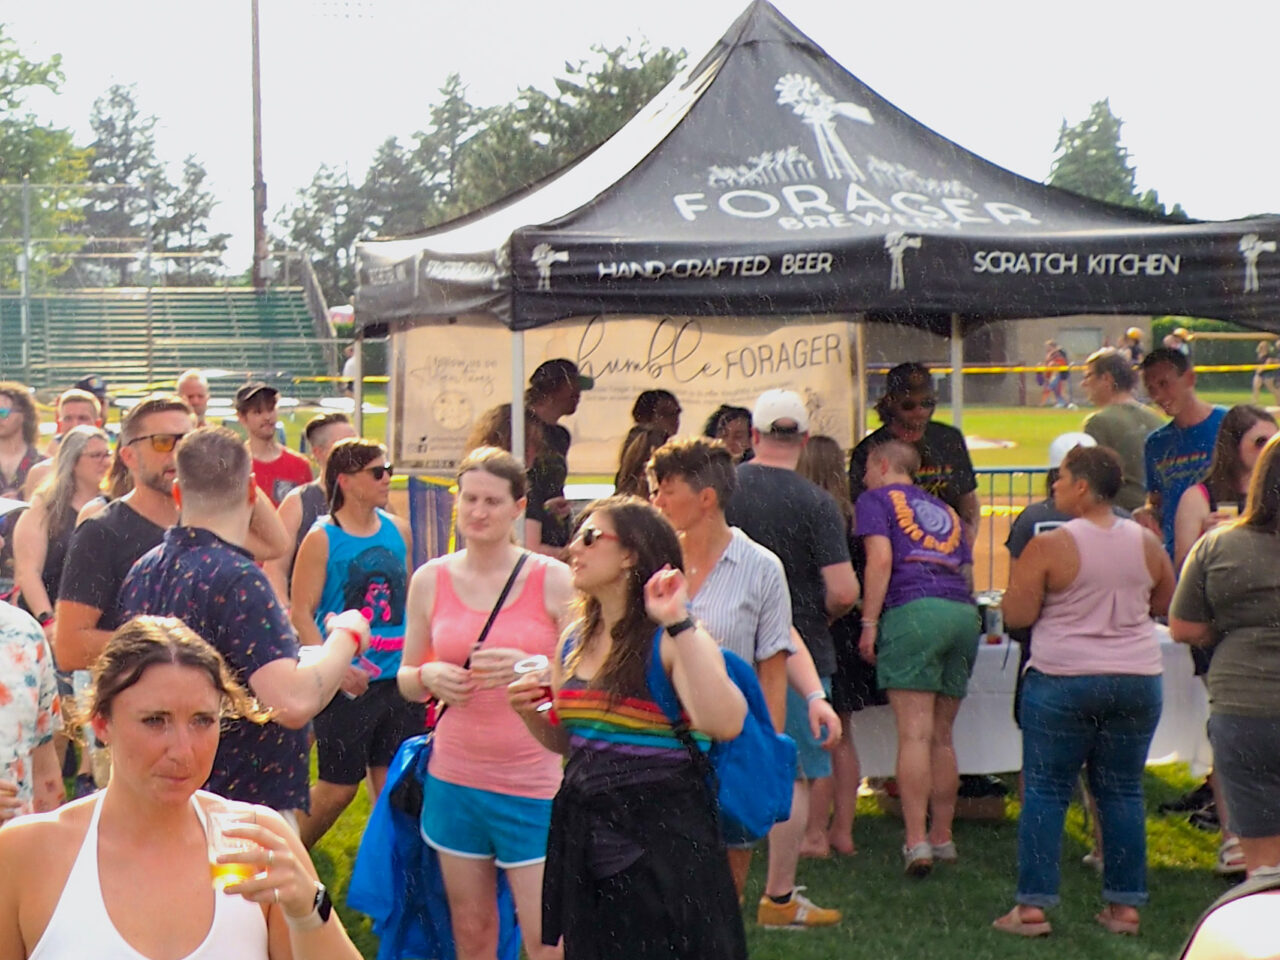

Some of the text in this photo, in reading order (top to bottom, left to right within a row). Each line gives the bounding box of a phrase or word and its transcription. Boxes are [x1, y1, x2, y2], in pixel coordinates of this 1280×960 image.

[673, 182, 1042, 226] FORAGER
[598, 253, 833, 280] HAND-CRAFTED BEER
[974, 251, 1180, 275] SCRATCH KITCHEN
[575, 314, 843, 383] humble FORAGER
